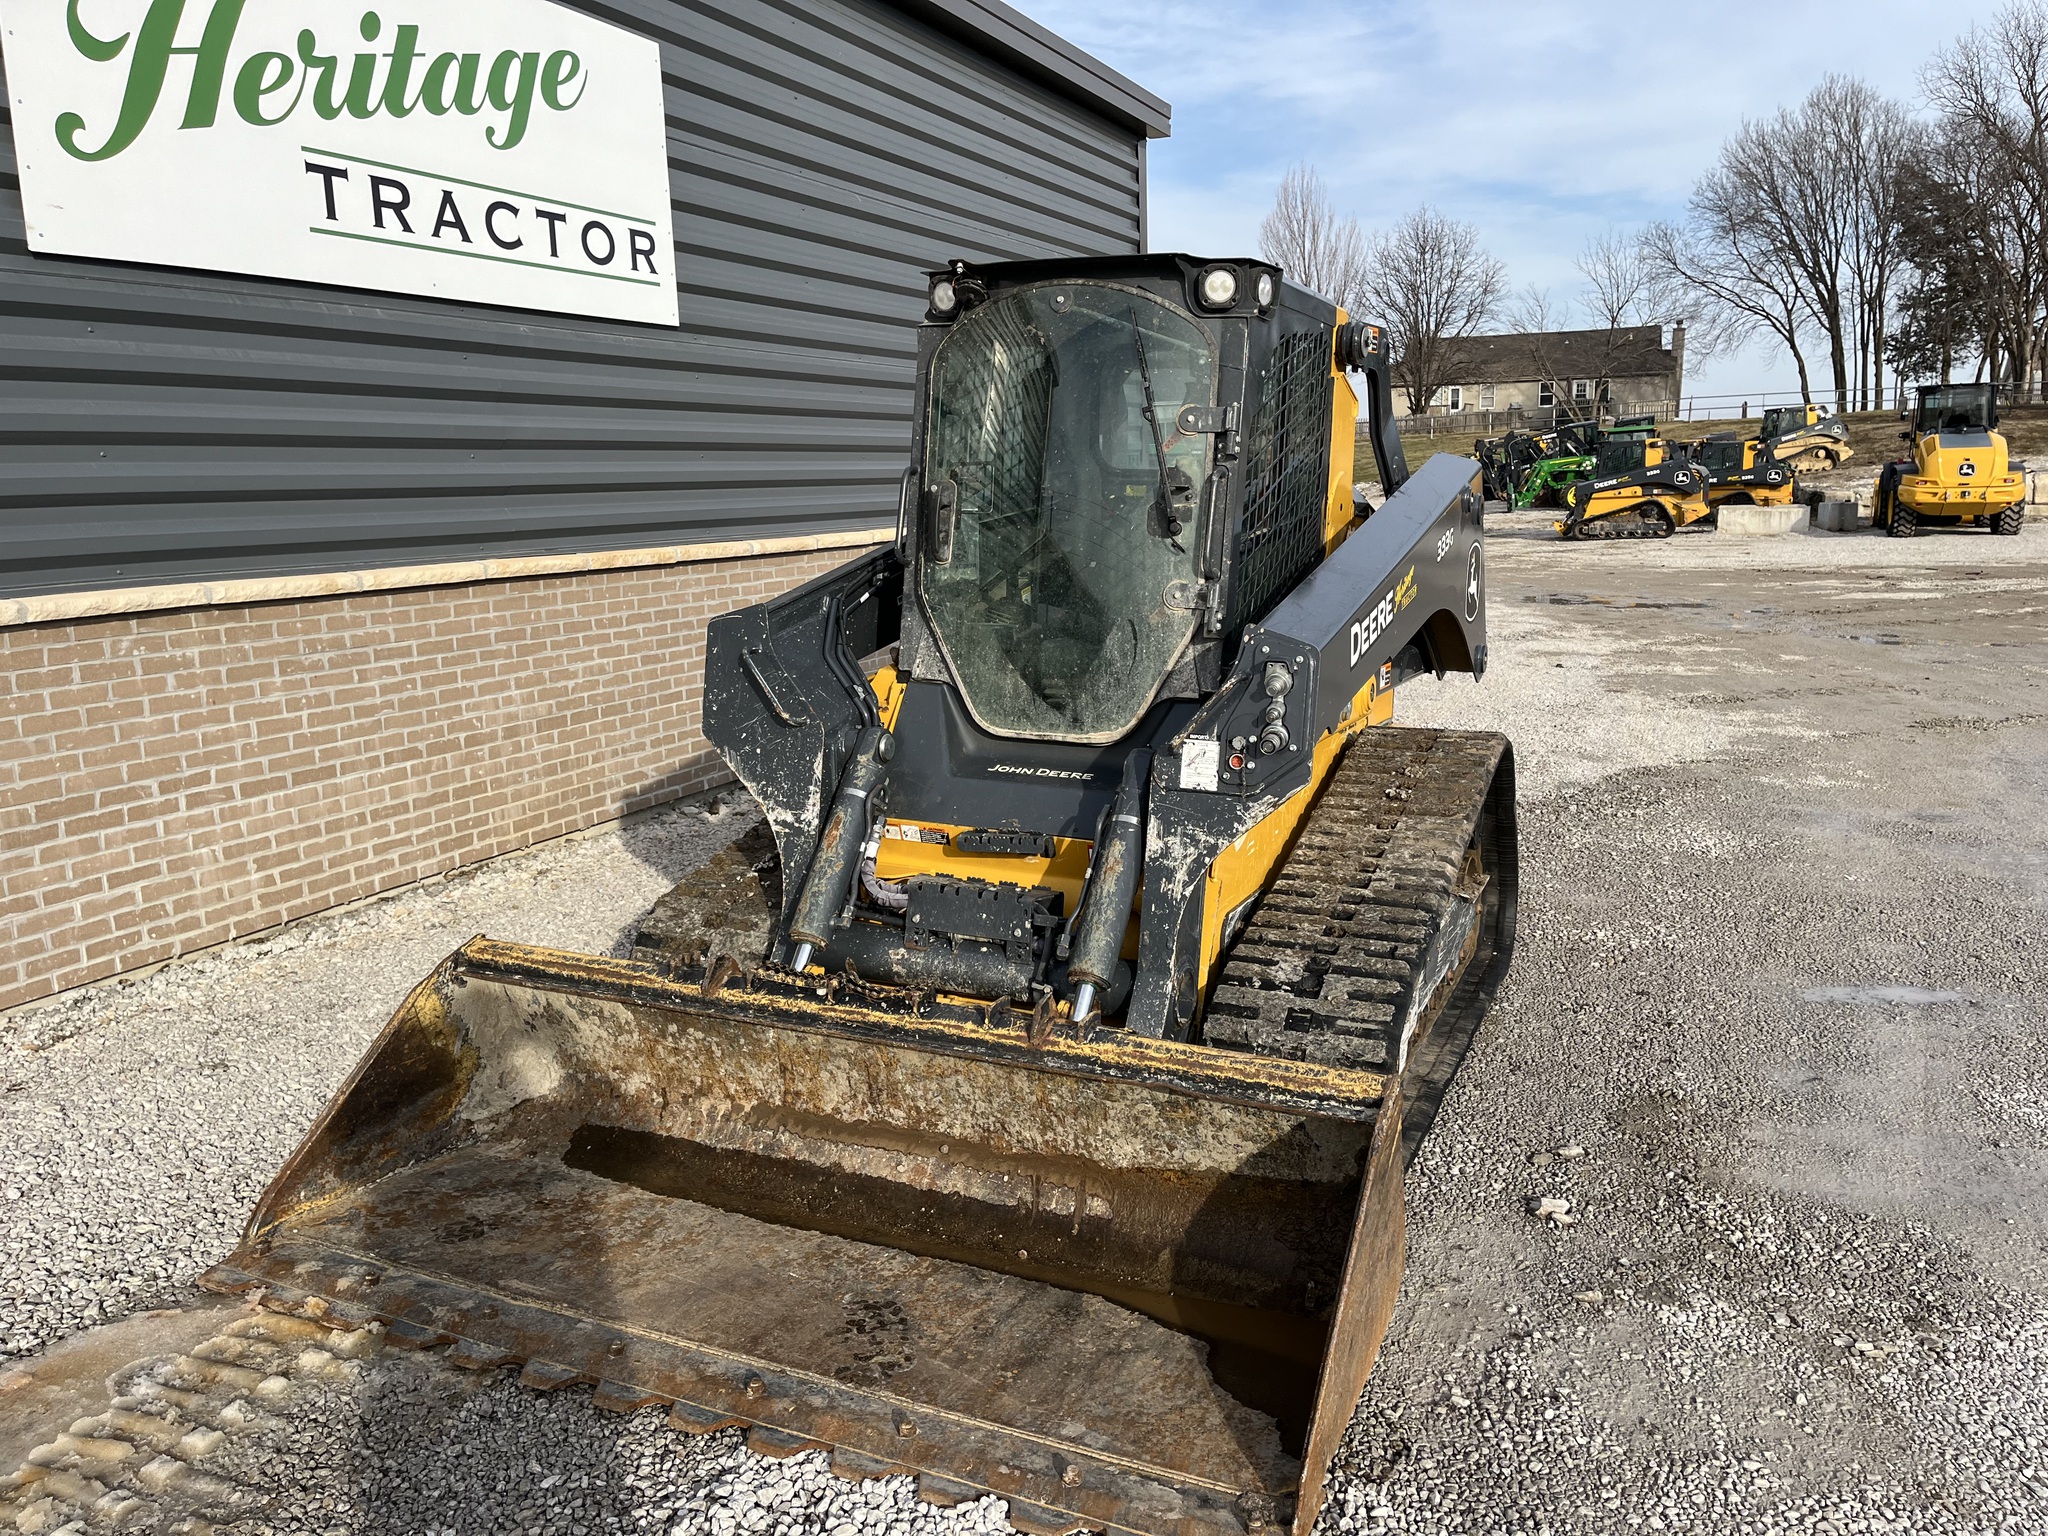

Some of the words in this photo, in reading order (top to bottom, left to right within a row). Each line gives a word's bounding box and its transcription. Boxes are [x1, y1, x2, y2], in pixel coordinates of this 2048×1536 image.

[55, 0, 587, 162] Heritage
[304, 159, 659, 275] TRACTOR
[1593, 479, 1618, 489] DEERE
[1437, 527, 1454, 562] 333G
[1350, 589, 1394, 668] DEERE
[987, 764, 1035, 775] JOHN
[1035, 767, 1095, 781] DEERE
